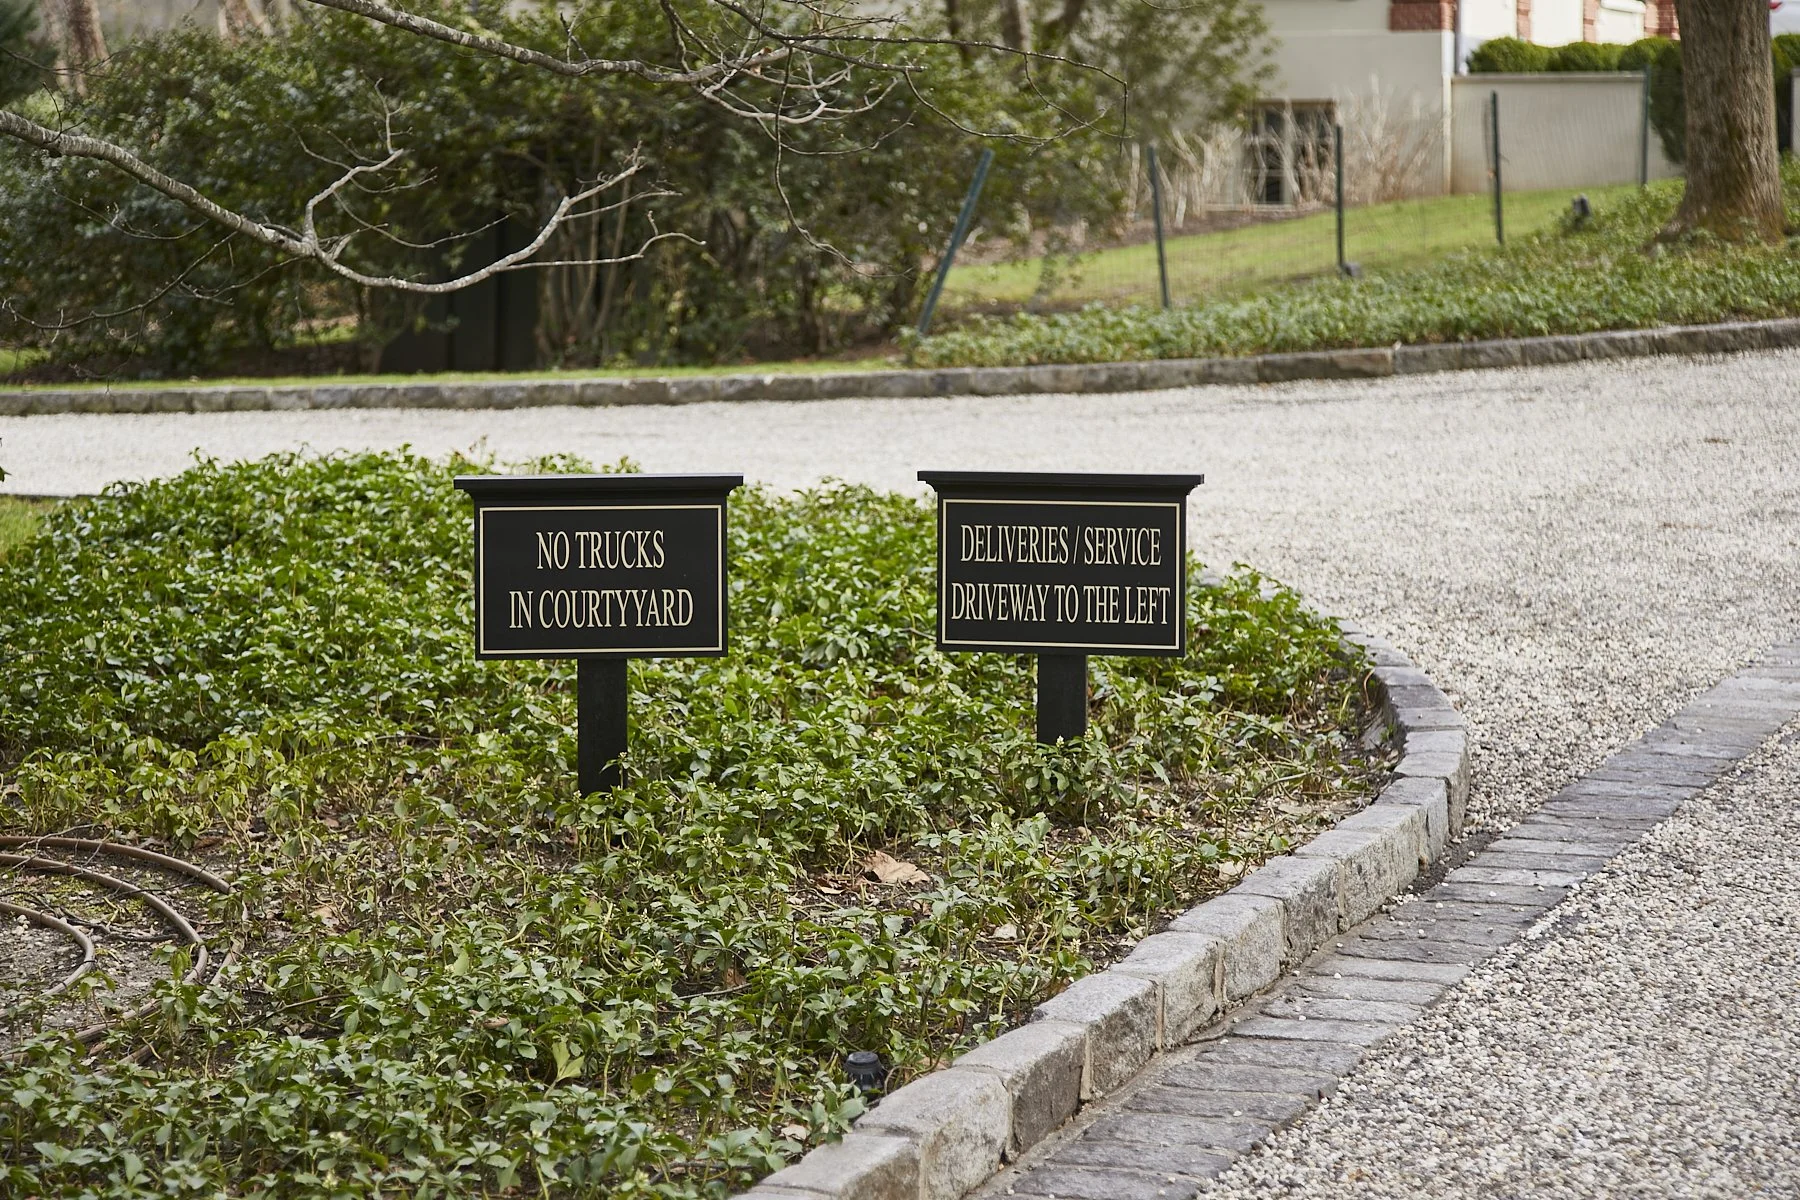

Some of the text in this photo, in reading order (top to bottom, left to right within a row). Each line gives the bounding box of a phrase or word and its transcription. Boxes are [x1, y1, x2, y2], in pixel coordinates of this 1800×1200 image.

[536, 530, 664, 569] NO TRUCKS
[961, 525, 1161, 565] DELIVERIES / SERVICE
[509, 589, 693, 628] IN COURTYYARD
[952, 583, 1170, 624] DRIVEWAY TO THE LEFT
